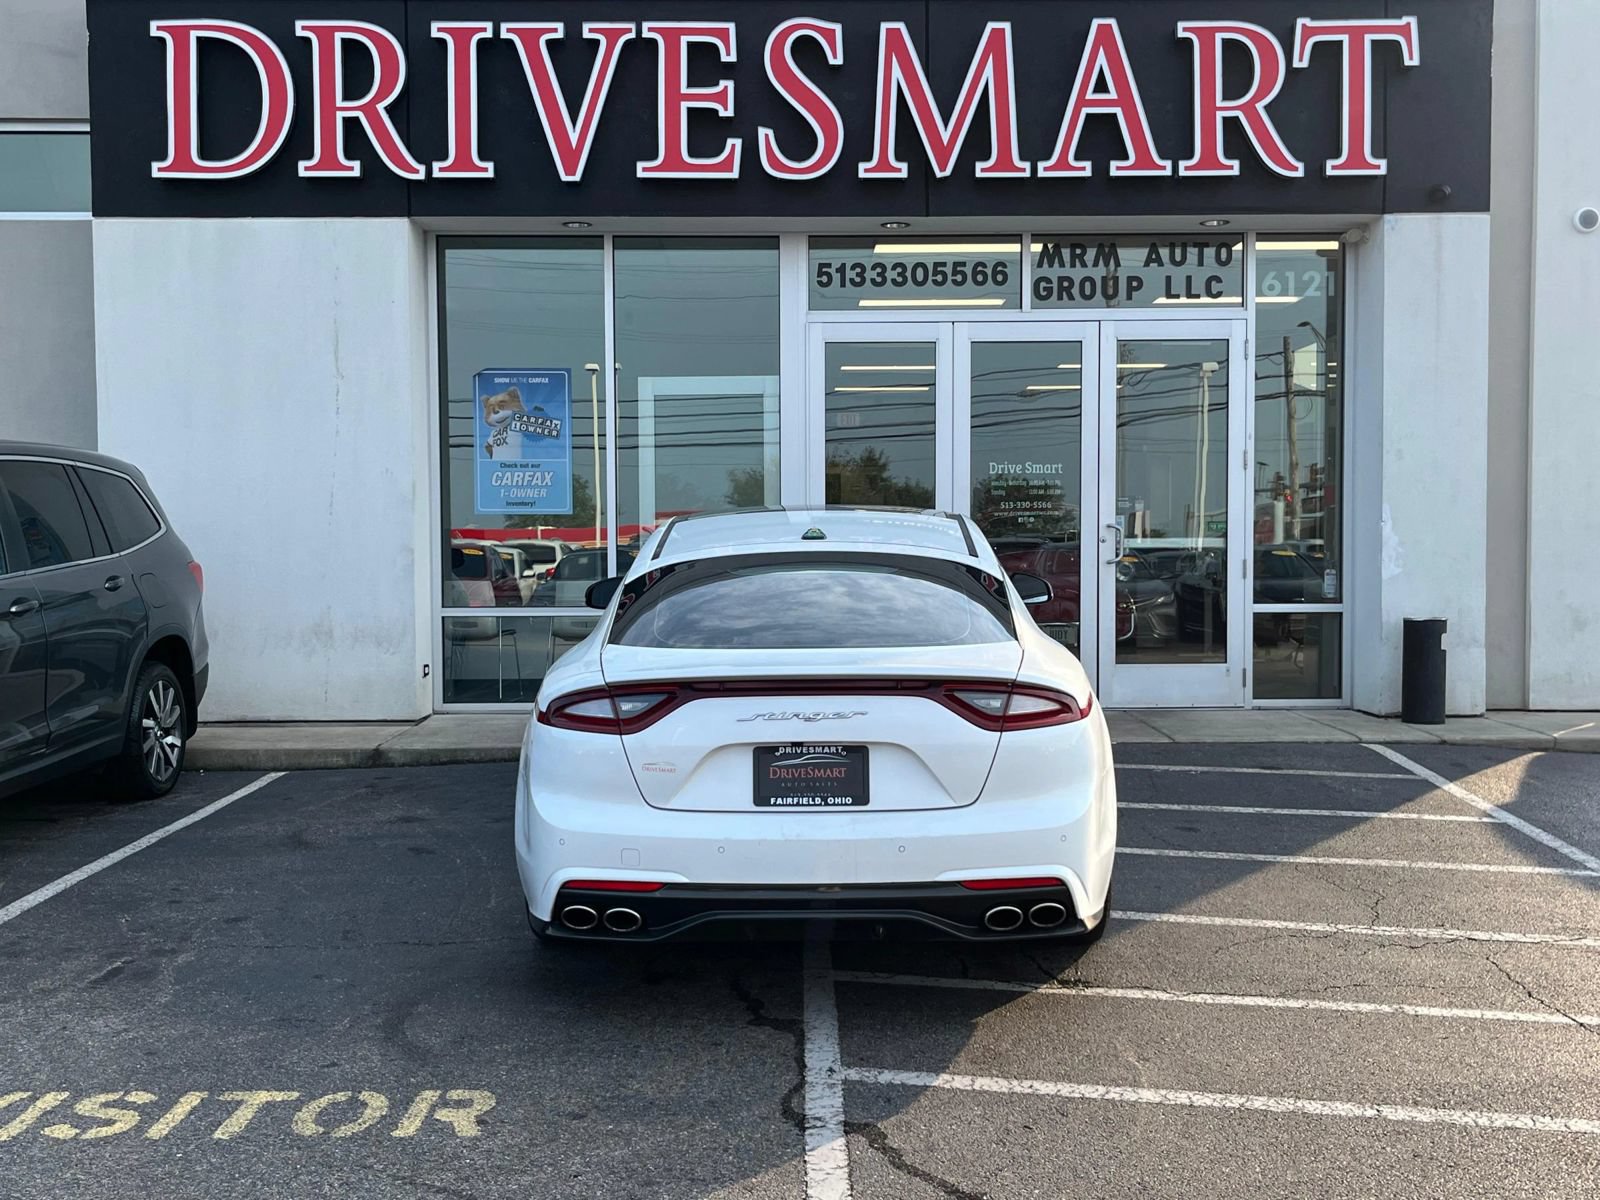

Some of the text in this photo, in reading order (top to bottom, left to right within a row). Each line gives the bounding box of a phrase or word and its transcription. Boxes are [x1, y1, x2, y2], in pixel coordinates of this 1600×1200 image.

[149, 15, 1420, 183] DRIVESMART
[1036, 241, 1234, 269] MRM AUTO
[816, 261, 1009, 288] 5133305566
[1032, 275, 1225, 301] GROUP LLC
[1261, 271, 1335, 297] 6121
[514, 412, 560, 430] CARFAX
[493, 427, 508, 438] CAR
[520, 425, 558, 438] OWNER
[492, 436, 509, 447] FOX
[989, 461, 1063, 474] Drive Smart
[491, 471, 554, 486] CARFAX
[1000, 501, 1052, 509] 513-330-5566
[778, 746, 843, 754] DRIVESMART
[770, 796, 853, 806] FAIRFIELD, OHIO
[0, 1088, 496, 1141] ISITOR
